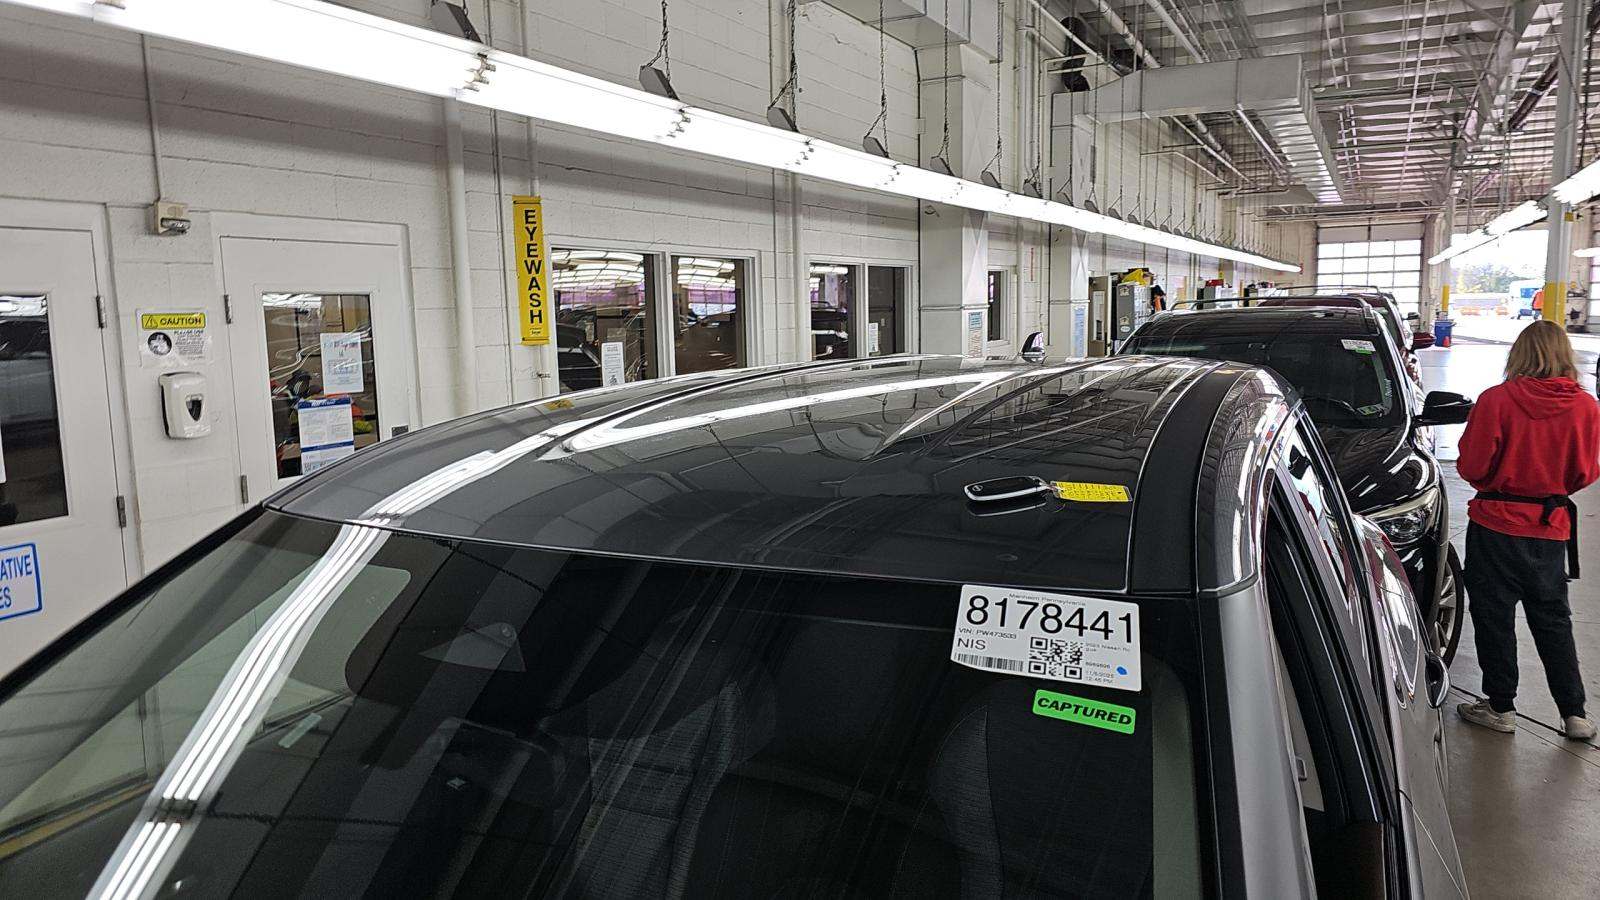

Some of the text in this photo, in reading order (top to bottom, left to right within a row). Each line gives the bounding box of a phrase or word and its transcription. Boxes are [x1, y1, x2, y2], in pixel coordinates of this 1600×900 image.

[524, 209, 543, 324] EYEWASH
[159, 316, 202, 326] CAUTION
[0, 555, 33, 581] ATIVE
[966, 594, 1132, 644] 8178441
[957, 637, 986, 650] NIS
[1037, 697, 1132, 725] CAPTURED
